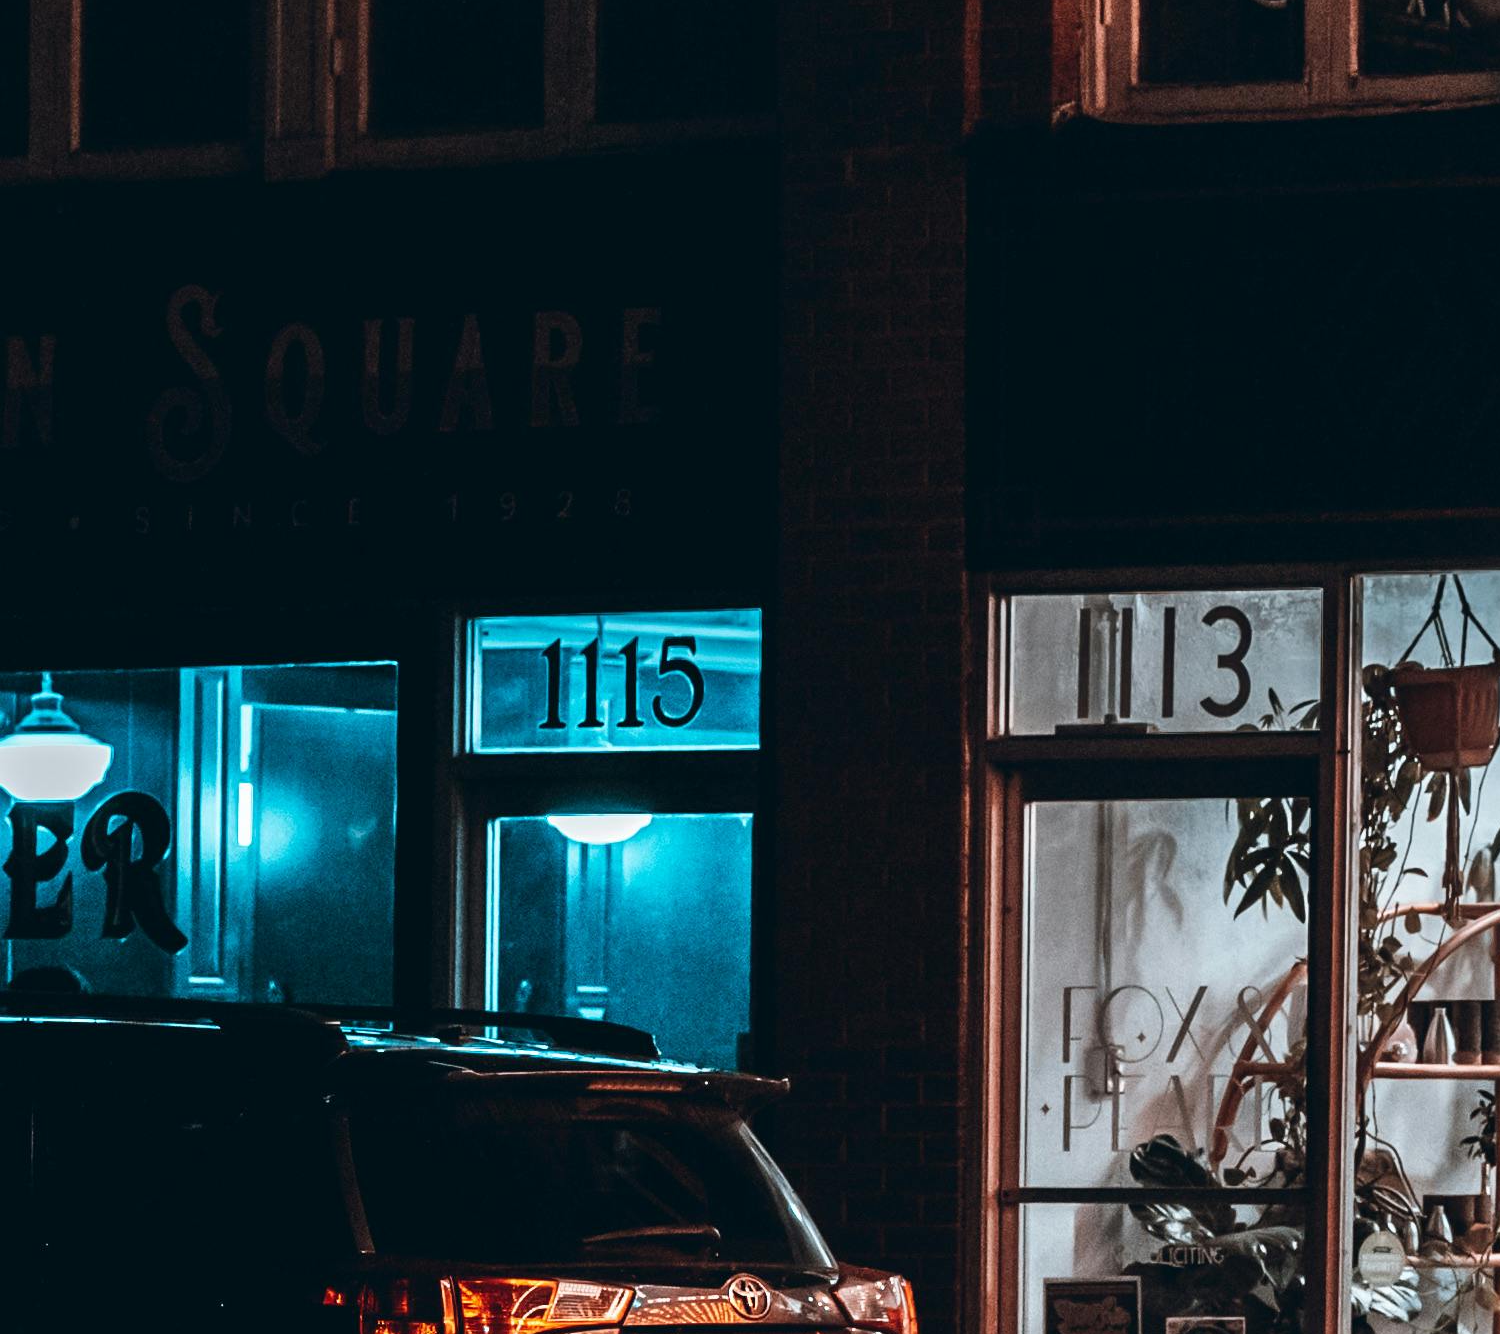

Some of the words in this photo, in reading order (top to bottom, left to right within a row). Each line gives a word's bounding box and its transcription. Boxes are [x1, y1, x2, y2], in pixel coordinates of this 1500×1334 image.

[539, 636, 706, 729] 1115
[1078, 605, 1252, 718] 1113
[1063, 985, 1207, 1063] FOX
